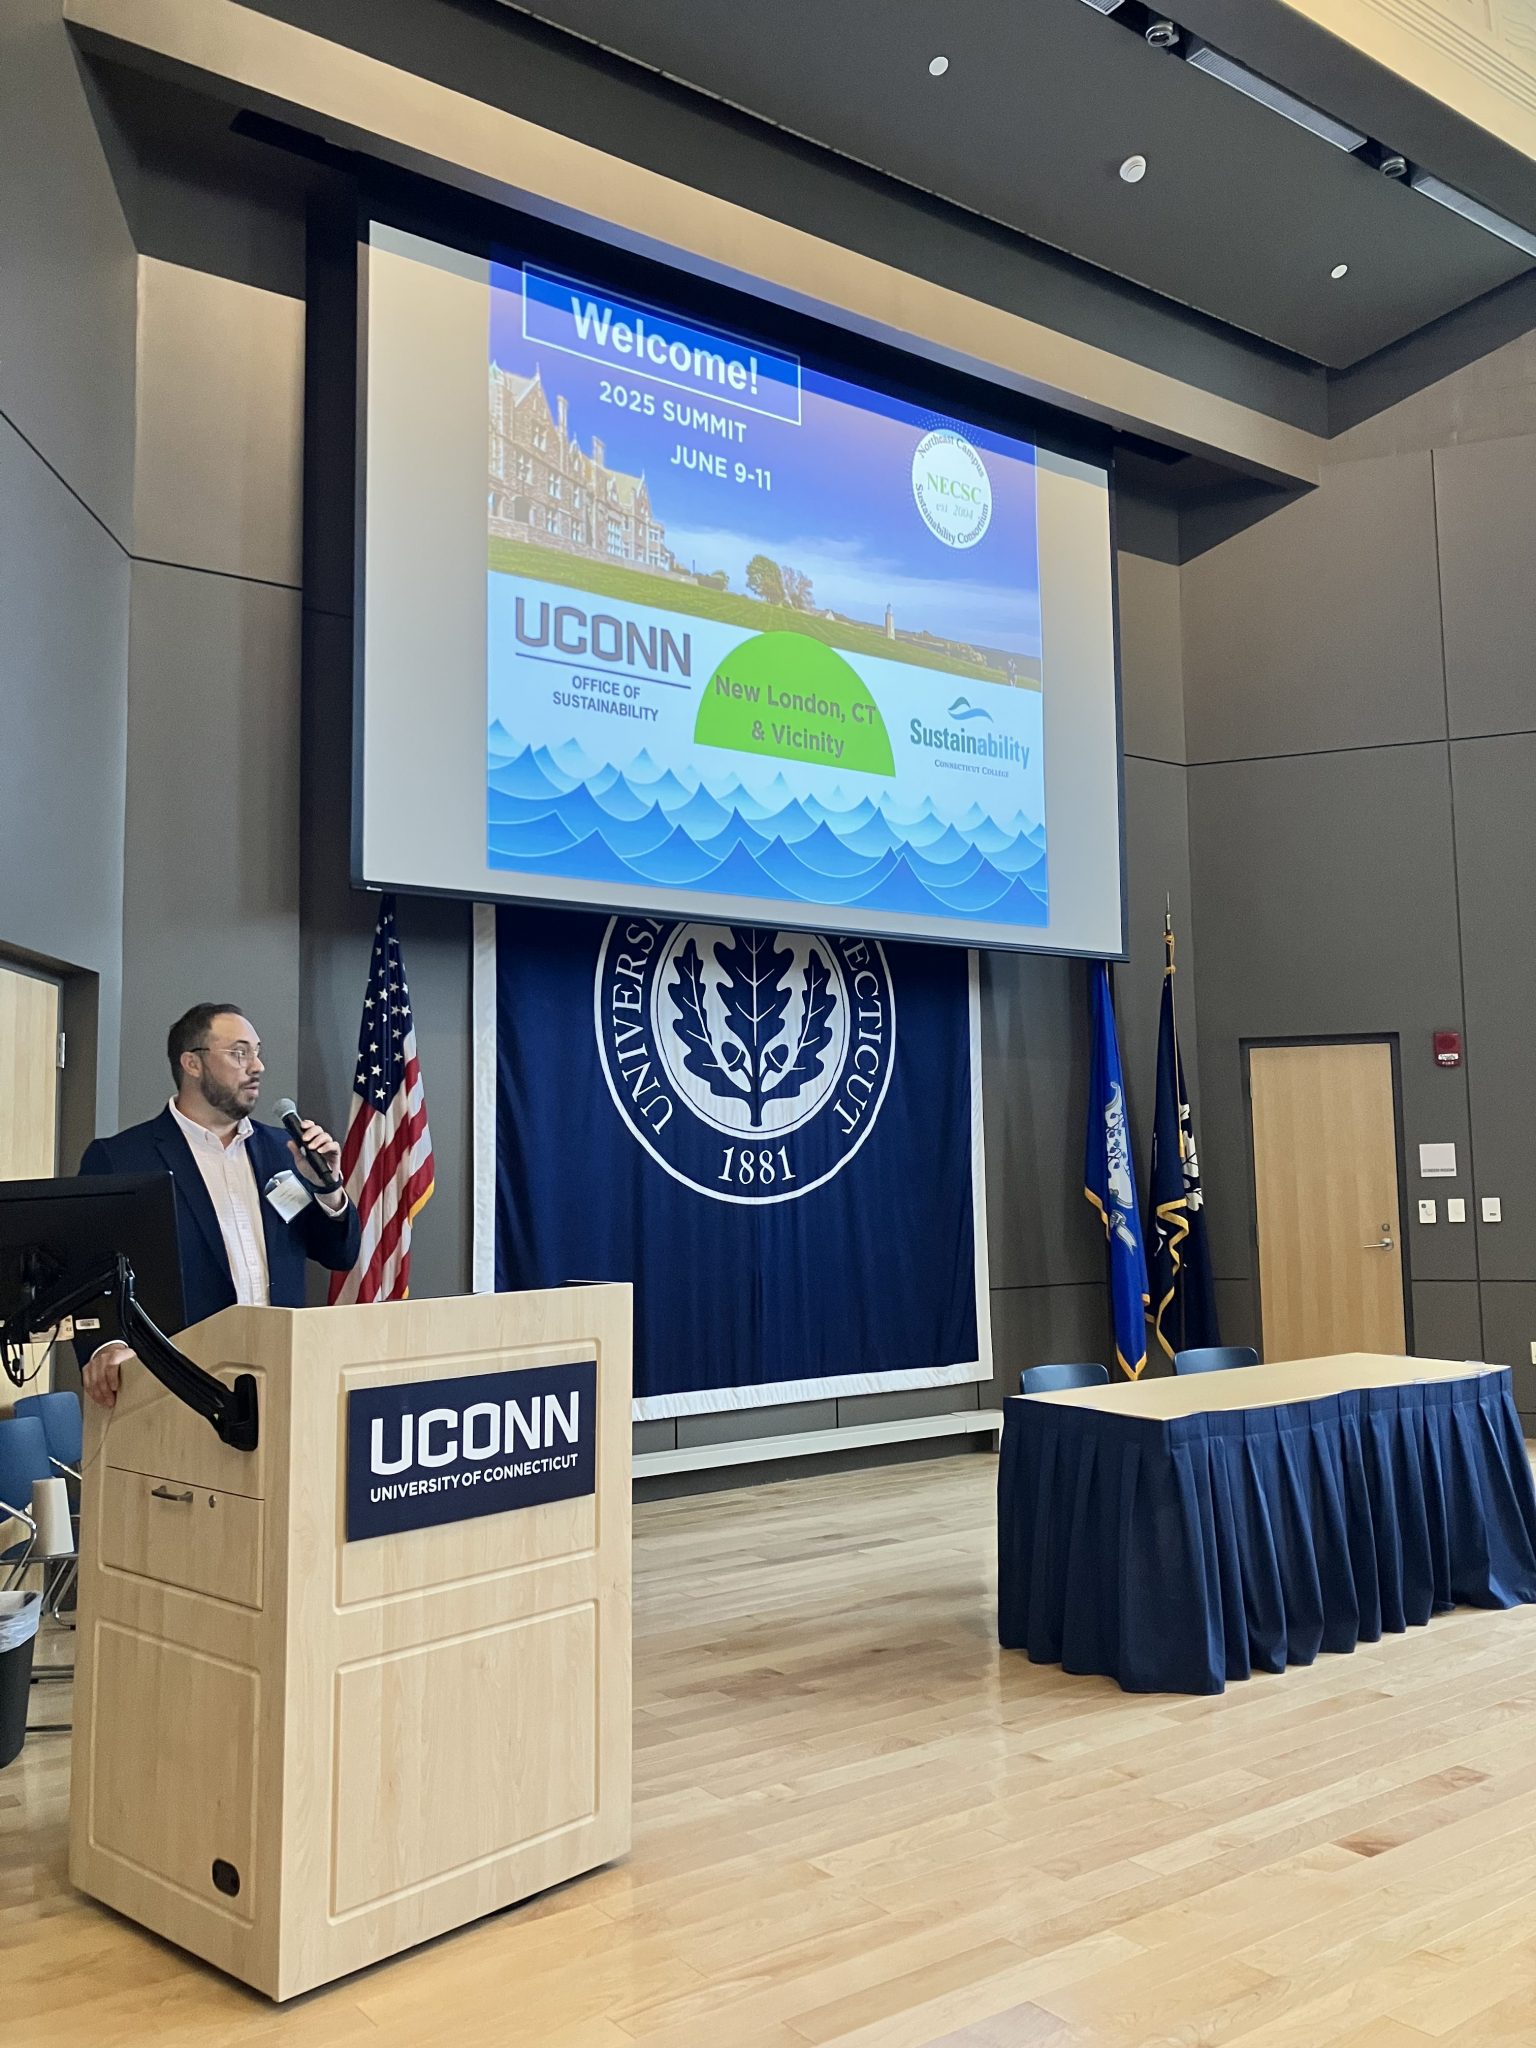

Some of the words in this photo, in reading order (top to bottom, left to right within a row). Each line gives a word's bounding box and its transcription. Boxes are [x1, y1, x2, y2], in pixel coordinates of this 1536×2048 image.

[571, 296, 758, 395] Welcome!
[599, 381, 655, 416] 2025
[663, 400, 747, 443] SUMMIT
[671, 444, 727, 478] JUNE
[734, 462, 772, 491] 9-11
[918, 433, 954, 459] Northeast
[956, 438, 985, 478] Campus
[927, 472, 982, 505] NECSC
[915, 483, 956, 545] Sustainability
[957, 503, 988, 544] Consortium
[515, 596, 691, 677] UCONN
[552, 691, 659, 722] SUSTAINABILITY
[572, 675, 620, 696] OFFICE
[623, 685, 641, 699] OF
[715, 675, 761, 703] New
[767, 685, 846, 723] London,
[852, 702, 876, 725] CT
[751, 720, 765, 741] &
[772, 722, 845, 759] Vicinity
[910, 718, 1030, 770] Sustainability
[833, 937, 882, 1134] ECTICUT
[718, 1145, 796, 1185] 1881
[371, 1390, 580, 1476] UCONN
[370, 1474, 461, 1503] UNIVERSITY
[461, 1470, 481, 1486] OF
[484, 1453, 579, 1483] CONNECTICUT
